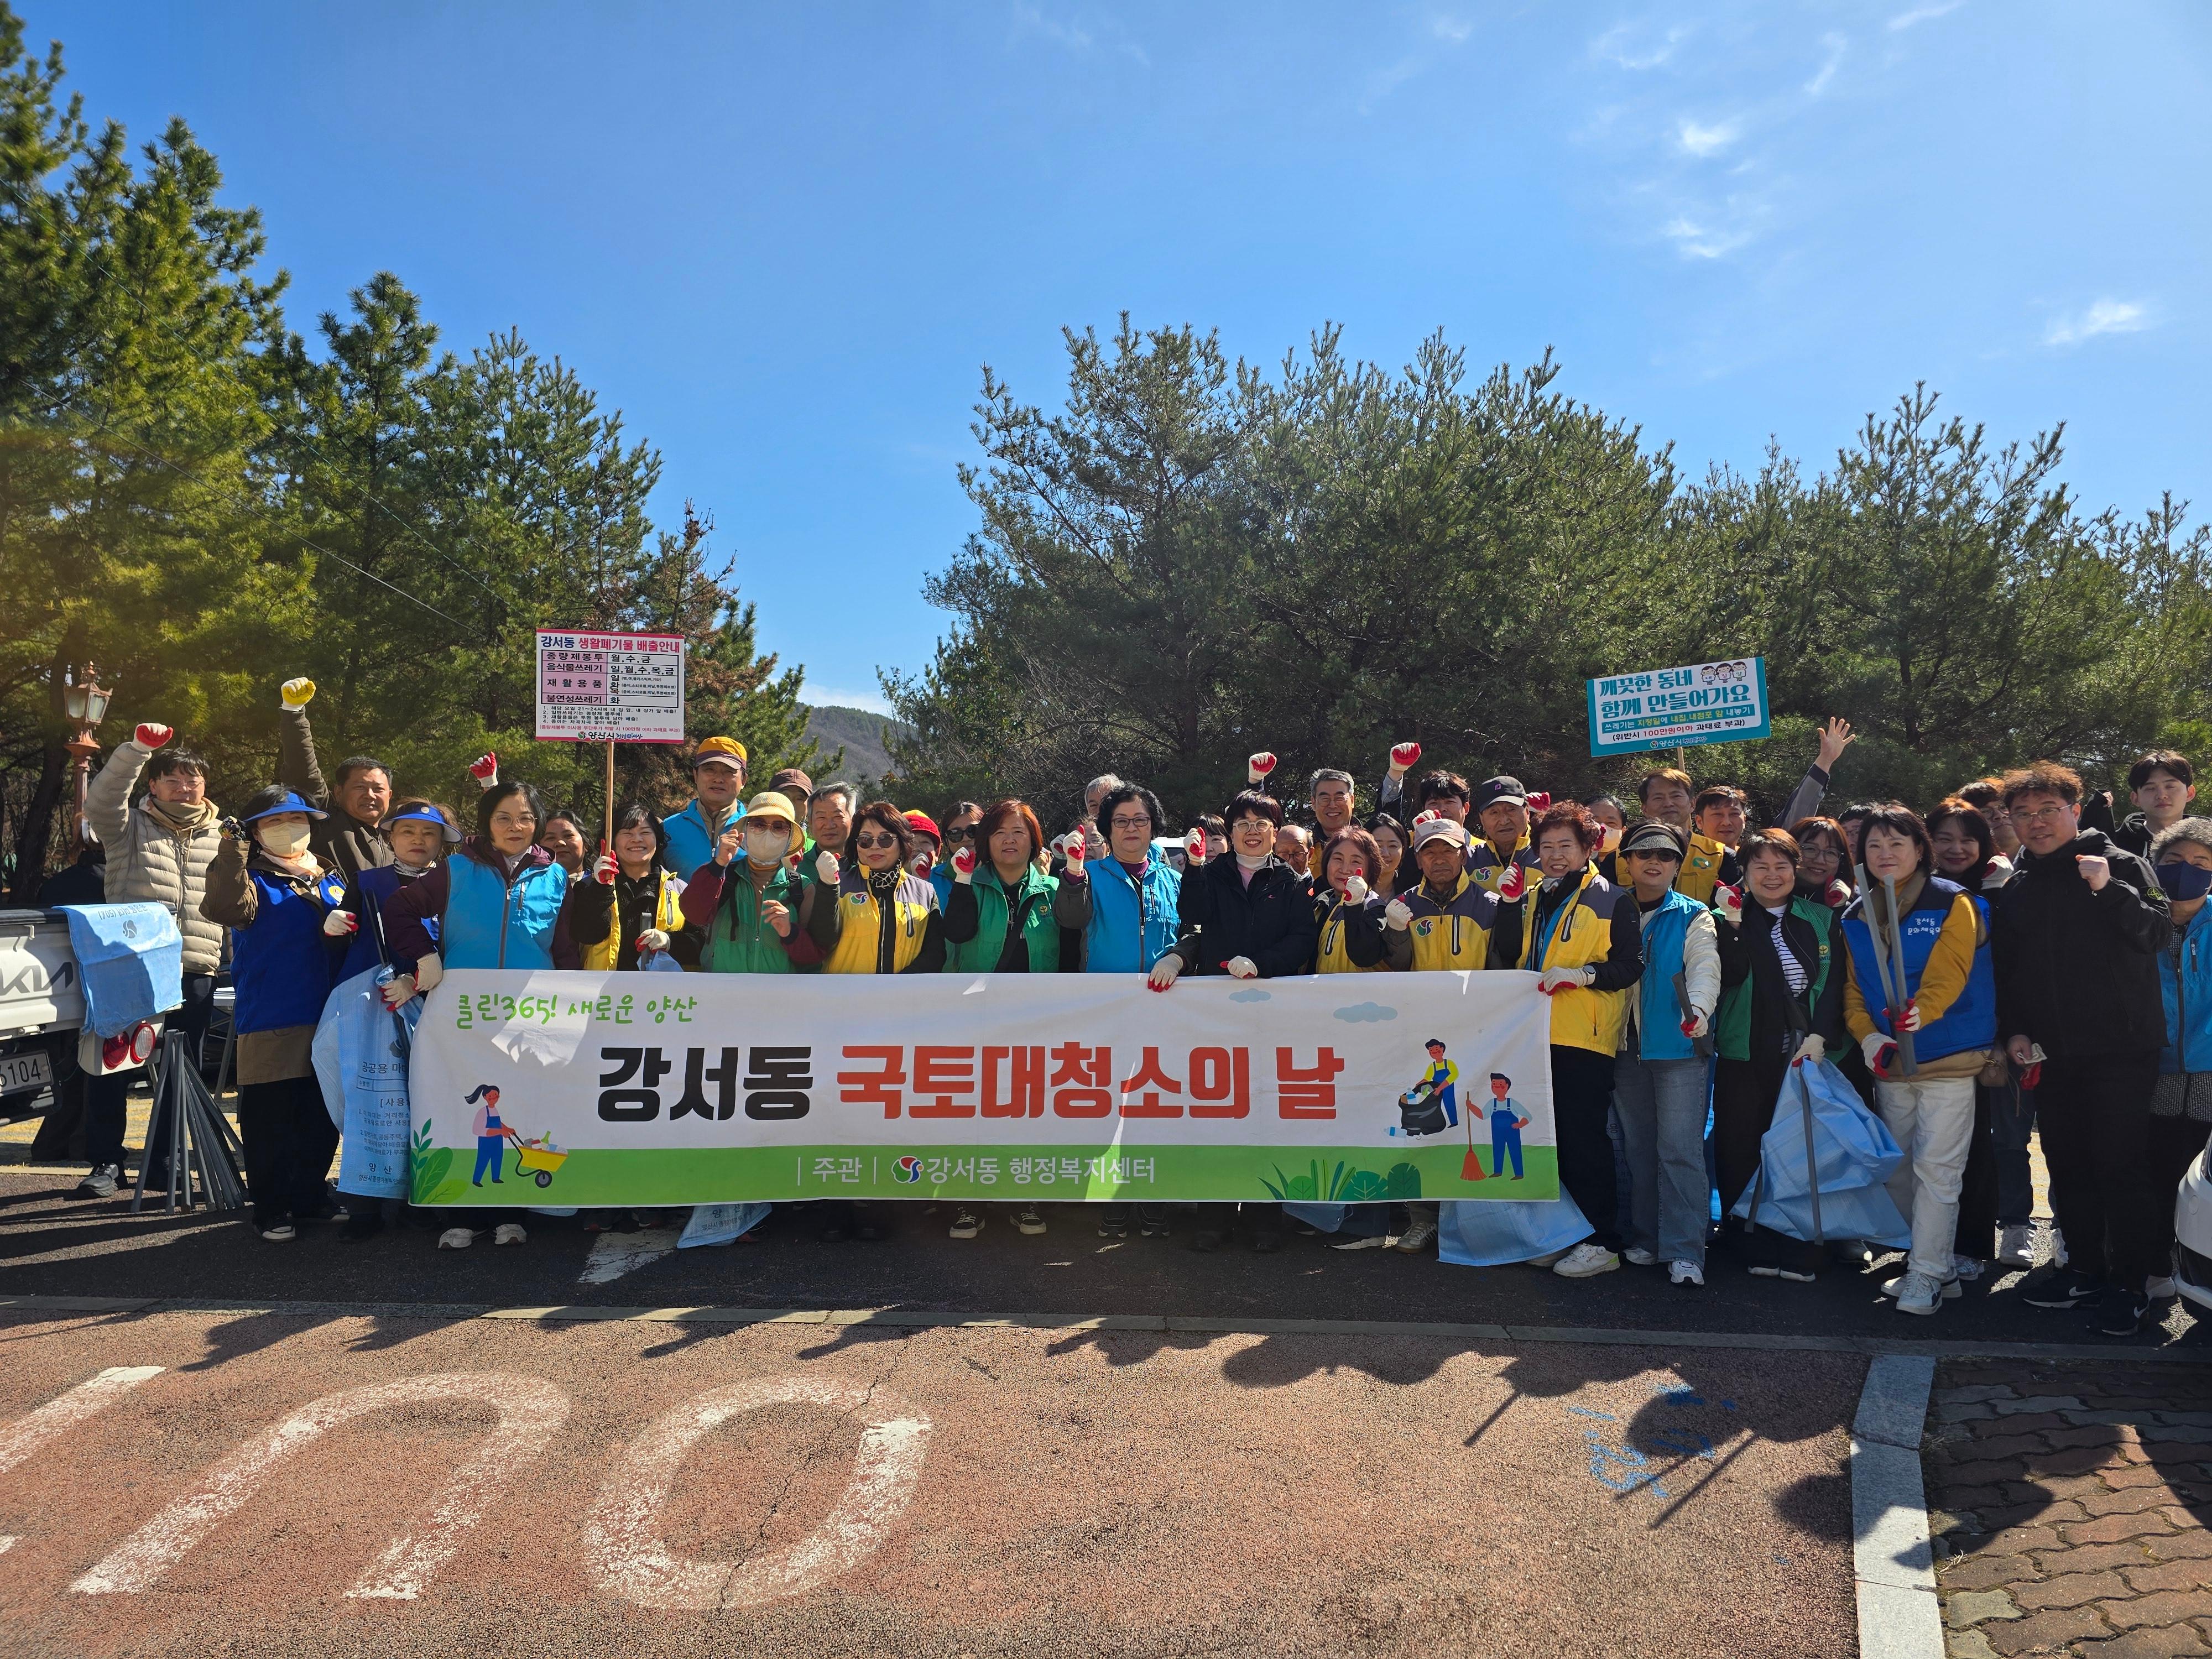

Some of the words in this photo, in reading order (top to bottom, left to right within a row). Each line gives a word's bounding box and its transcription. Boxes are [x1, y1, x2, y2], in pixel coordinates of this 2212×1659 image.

[541, 636, 575, 648] 강서동
[578, 638, 633, 651] 생활폐기물
[637, 640, 680, 653] 배출안내
[547, 652, 603, 661] 종량제봉투
[546, 663, 602, 672] 음식물쓰레기
[547, 679, 602, 688] 재활용품
[1599, 675, 1652, 697] 깨끗한
[1658, 669, 1693, 689] 동네
[546, 695, 602, 703] 불연성쓰레기
[1600, 697, 1641, 718] 함께
[1647, 684, 1751, 713] 만들어가요
[1605, 721, 1635, 731] 쓰레기는
[1637, 716, 1668, 727] 지정일에
[1726, 706, 1750, 716] 내놓기
[588, 732, 614, 740] 양산시
[1613, 732, 1640, 741] (위반시
[1643, 725, 1693, 737] 100만원이하
[1696, 722, 1721, 731] 과태료
[1659, 738, 1682, 747] 양산시
[1914, 918, 1935, 926] 강서동
[456, 993, 558, 1029] 클린365!
[567, 994, 634, 1024] 새로운
[646, 995, 698, 1024] 양산
[362, 1061, 388, 1074] 공공용
[597, 1046, 813, 1122] 강서동
[837, 1041, 1250, 1120] 국토대청소의
[1276, 1047, 1345, 1120] 날
[812, 1157, 861, 1183] 주관
[927, 1157, 1000, 1185] 강서동
[1009, 1157, 1156, 1185] 행정복지센터
